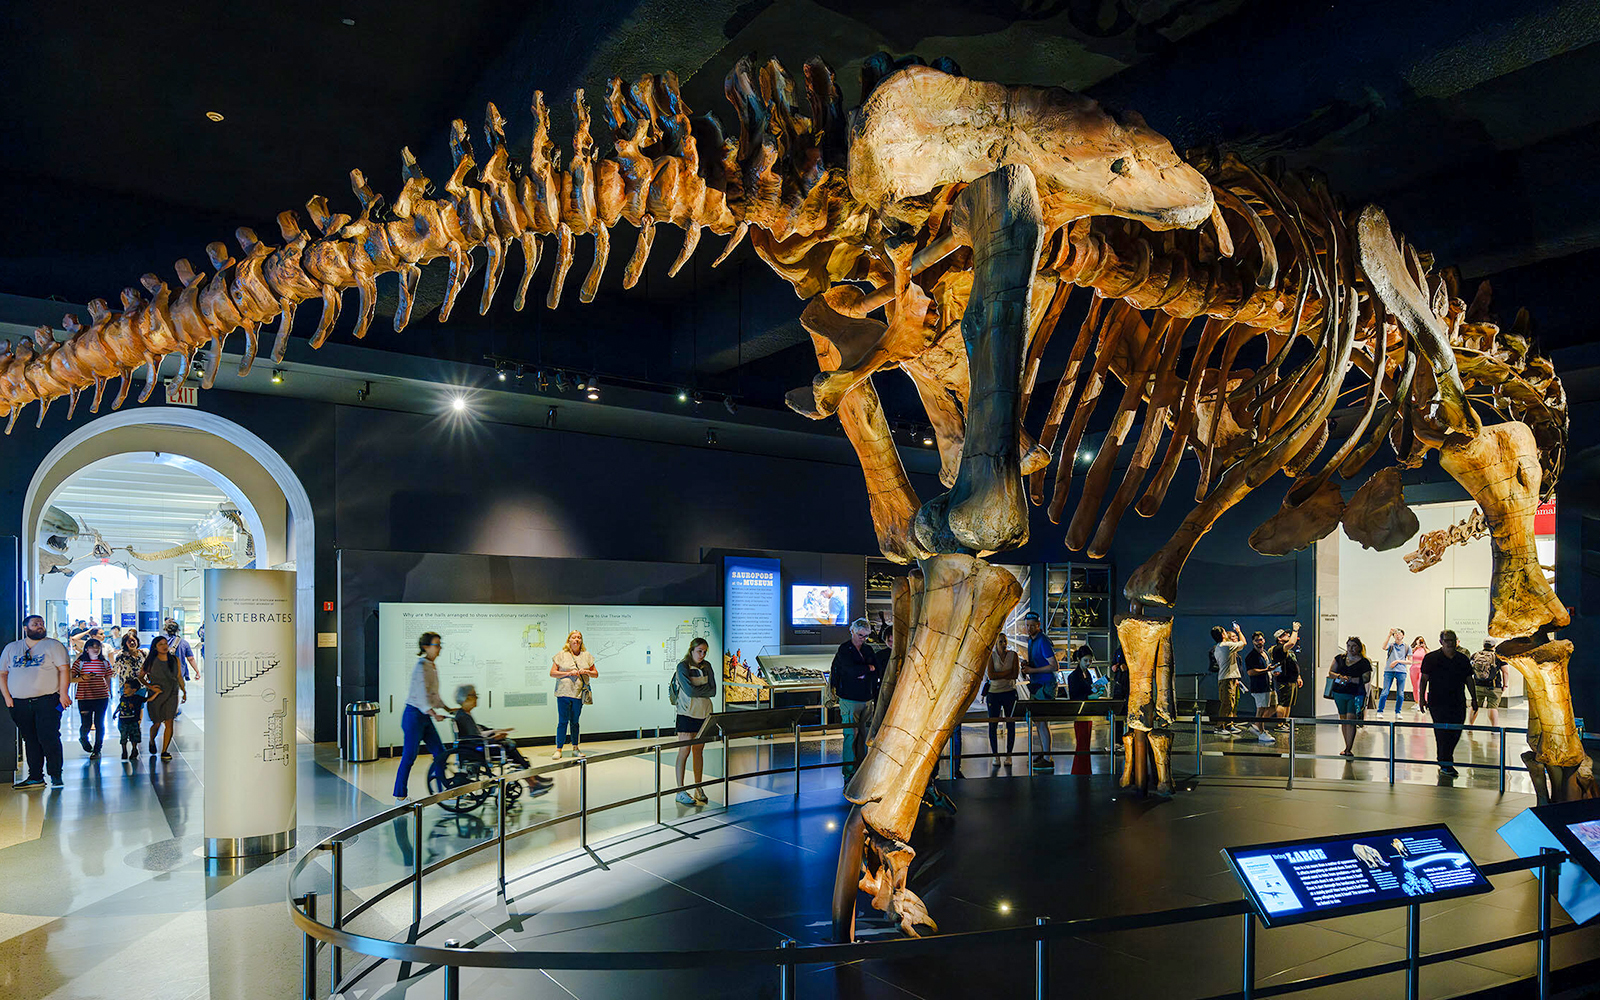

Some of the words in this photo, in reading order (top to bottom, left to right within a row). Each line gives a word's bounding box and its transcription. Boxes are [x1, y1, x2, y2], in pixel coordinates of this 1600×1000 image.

[731, 571, 774, 580] SAUROPODS
[743, 579, 774, 587] MUSEUM
[211, 612, 293, 623] VERTEBRATES
[1284, 848, 1328, 864] LARGE
